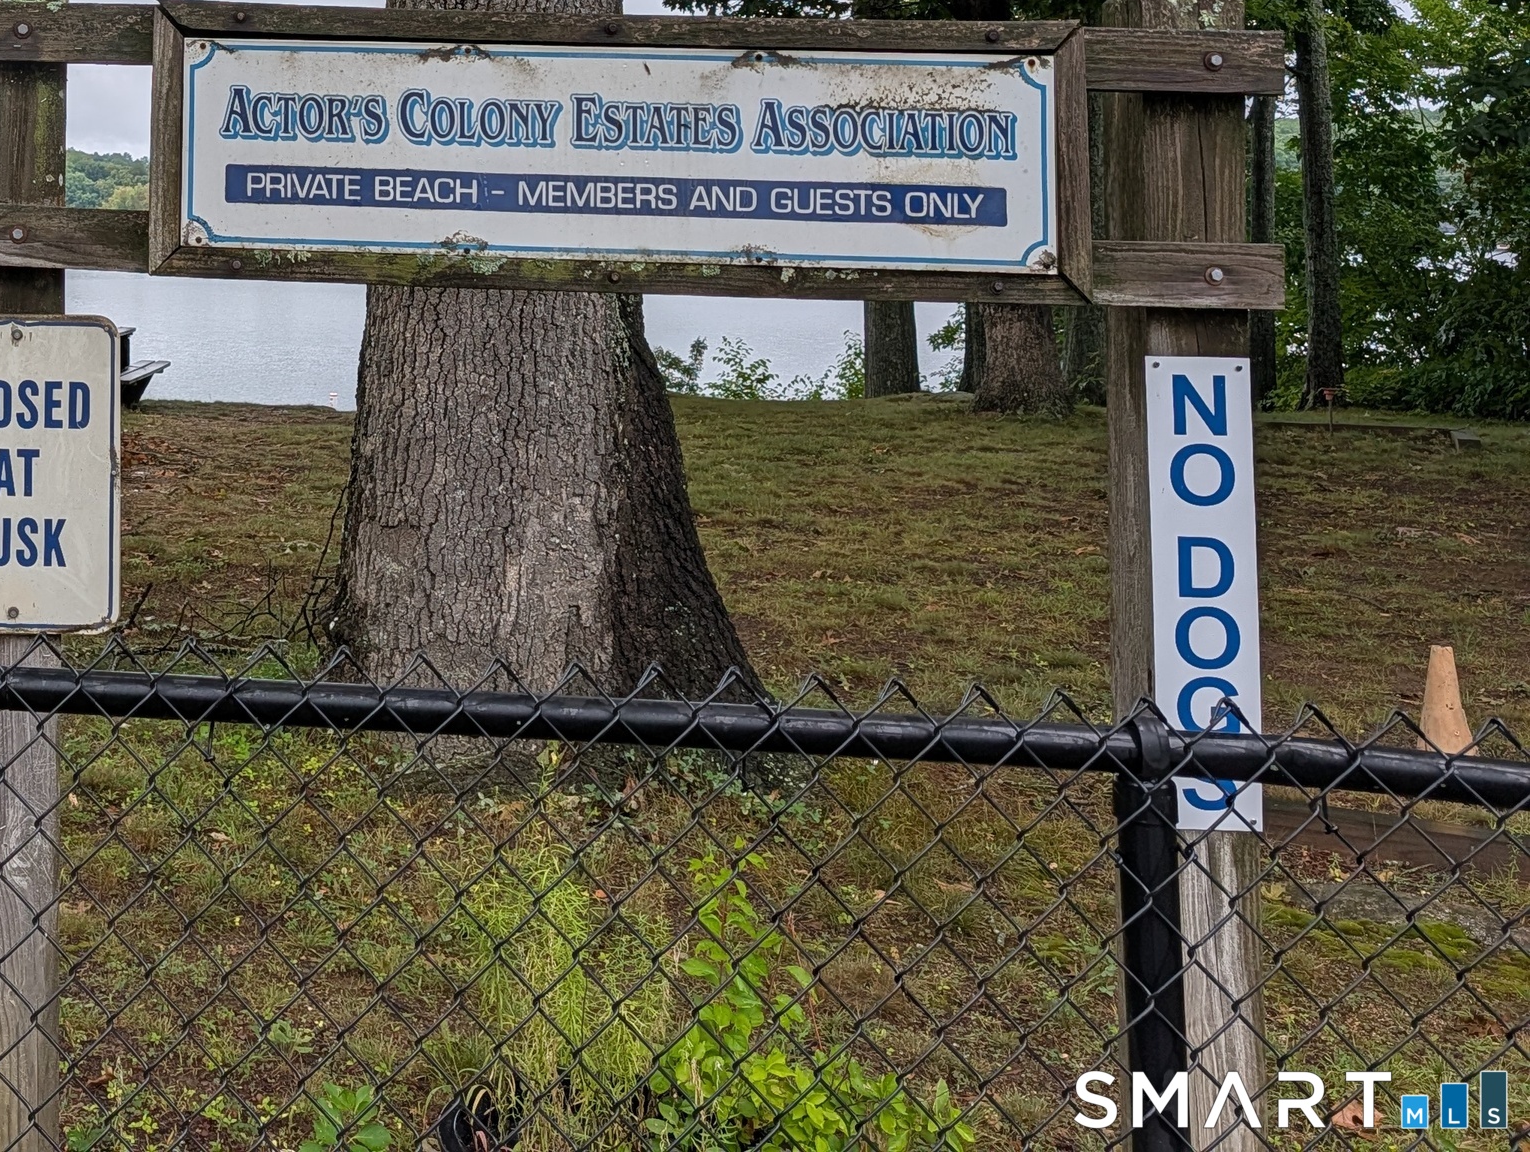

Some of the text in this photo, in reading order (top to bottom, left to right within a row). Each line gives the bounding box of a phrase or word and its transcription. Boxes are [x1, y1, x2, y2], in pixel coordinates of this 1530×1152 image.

[219, 84, 1018, 161] ACTOR'S COLONY ESTATES ASSOCIATION
[246, 172, 361, 200] PRIVATE
[374, 176, 477, 204] BEACH
[518, 181, 678, 210] MEMBERS
[689, 185, 758, 212] AND
[770, 188, 892, 217] GUESTS
[904, 191, 984, 219] ONLY
[1169, 374, 1236, 507] NO
